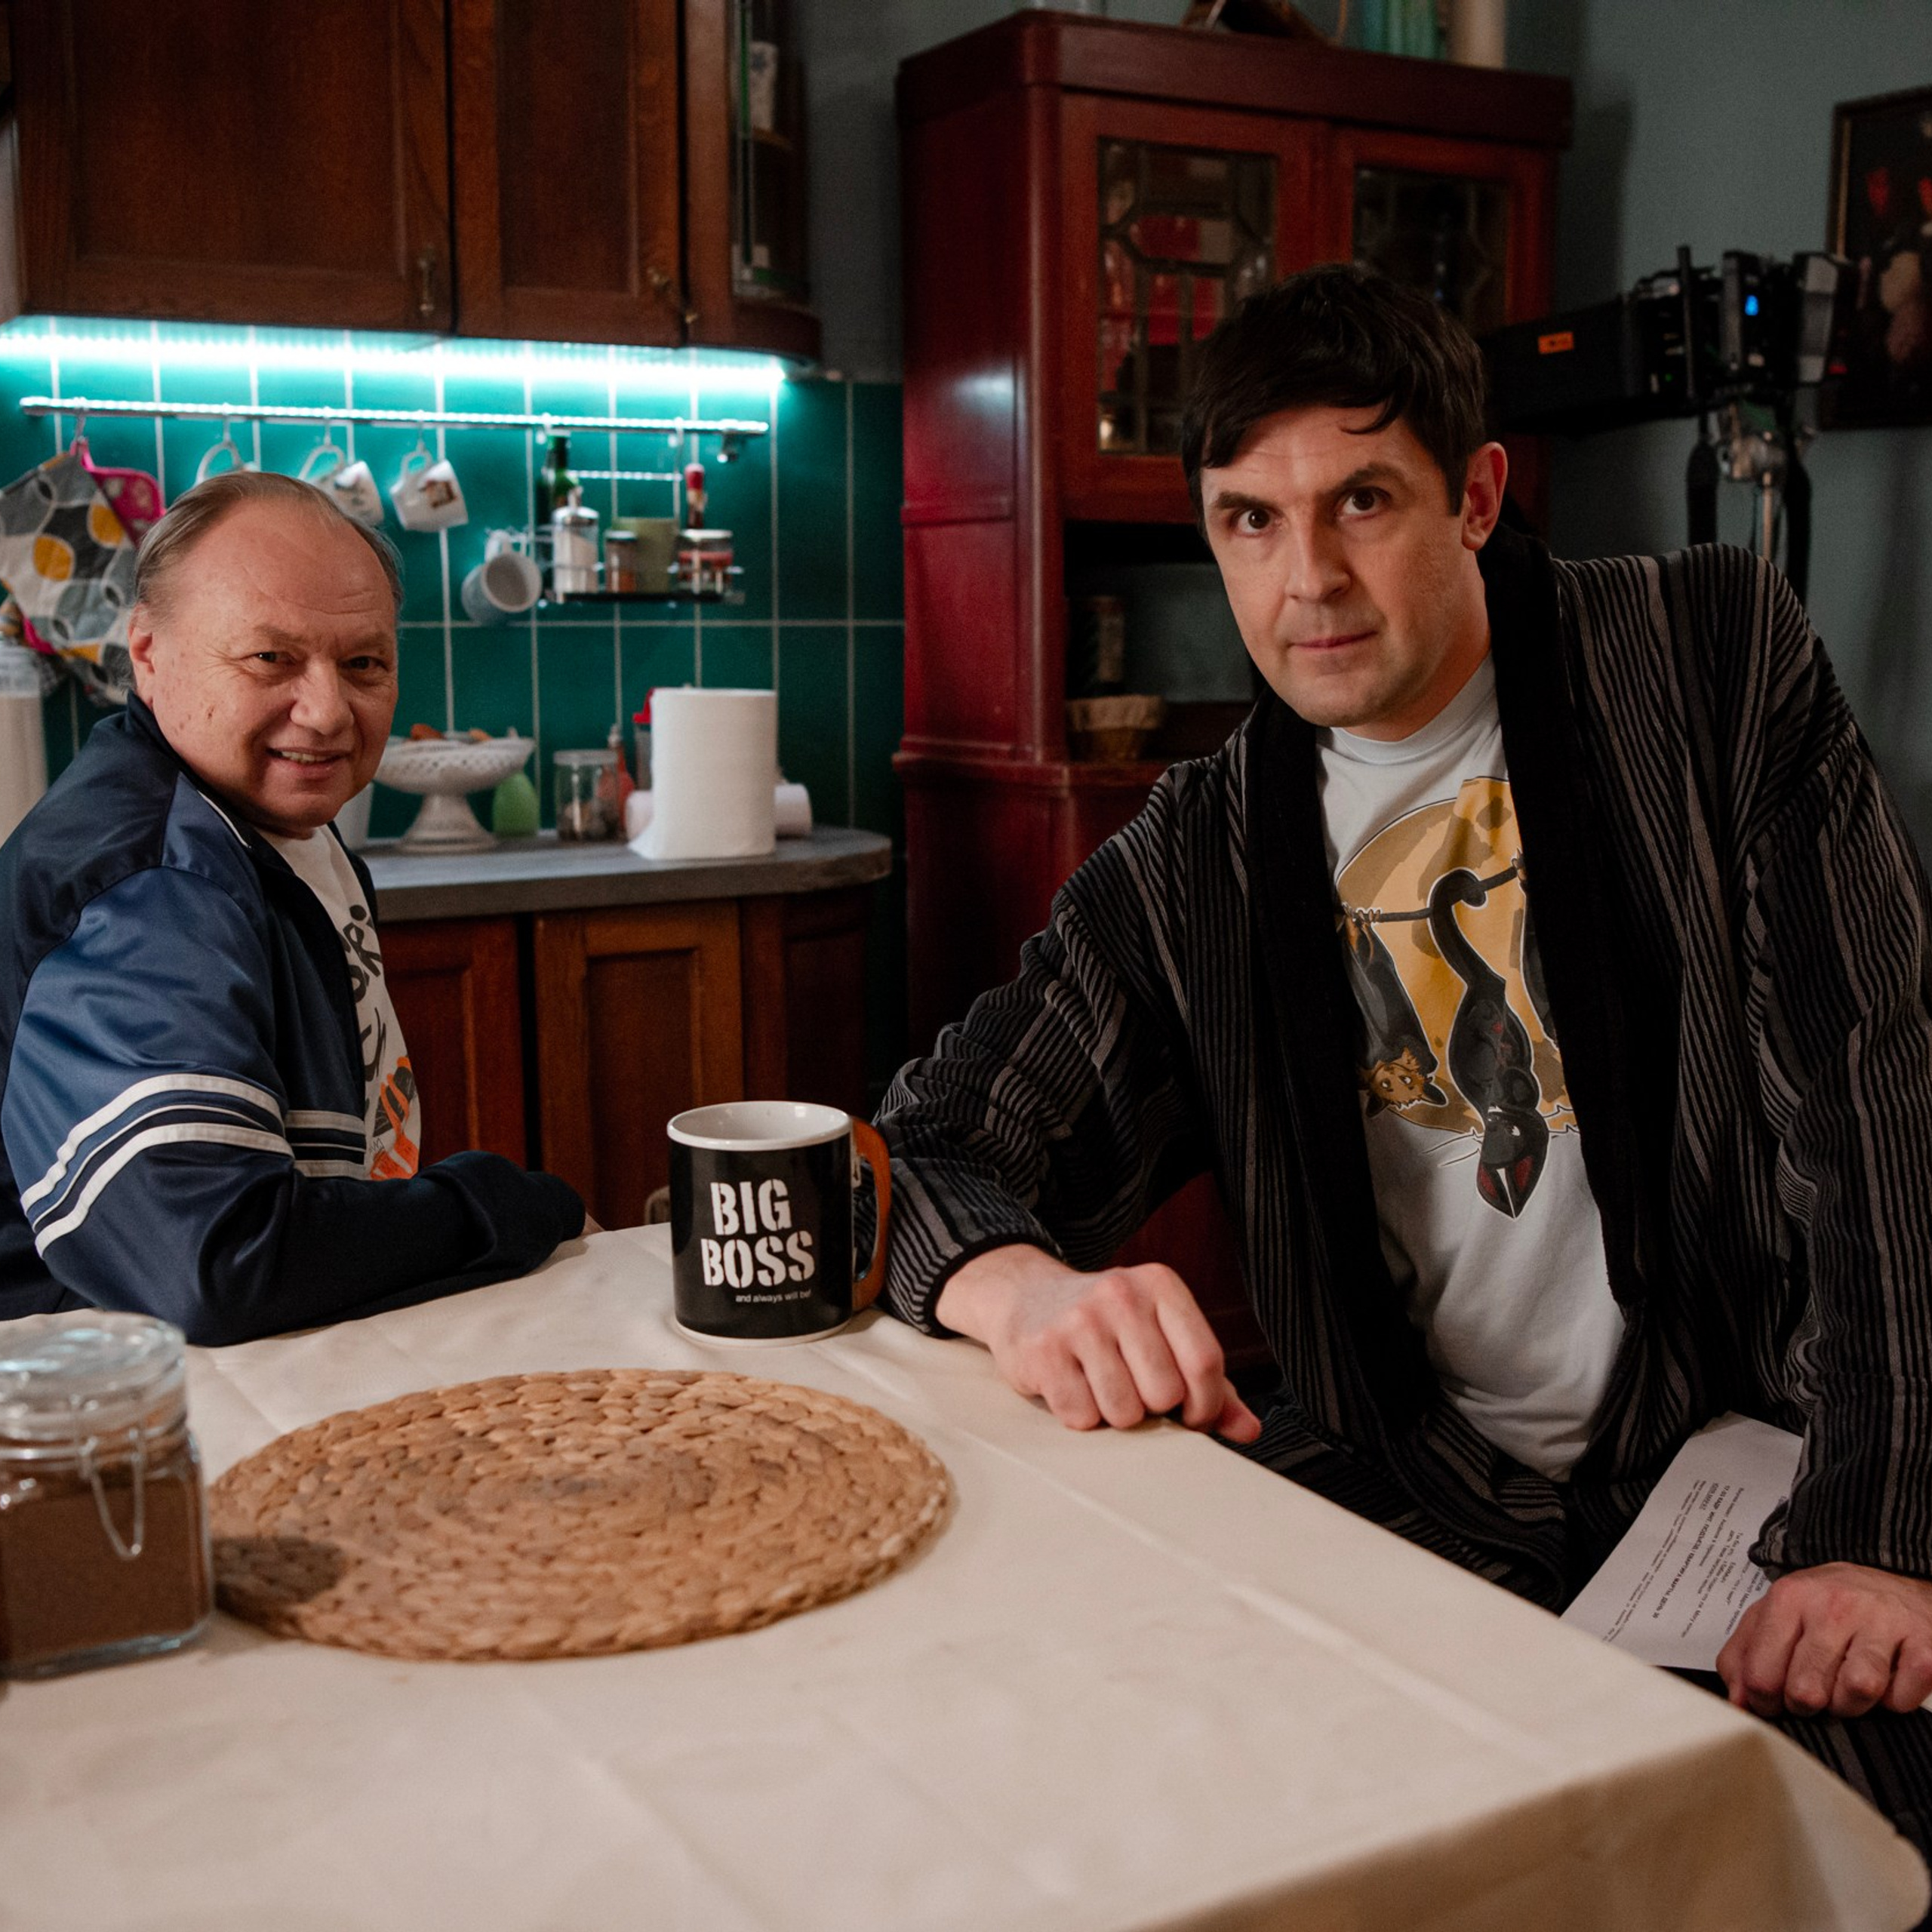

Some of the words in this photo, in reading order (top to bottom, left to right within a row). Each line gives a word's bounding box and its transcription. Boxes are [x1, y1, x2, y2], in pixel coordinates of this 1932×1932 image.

[710, 1178, 792, 1235] BIG
[700, 1230, 815, 1288] BOSS
[736, 1294, 752, 1303] and
[753, 1292, 783, 1303] always
[785, 1291, 798, 1300] will
